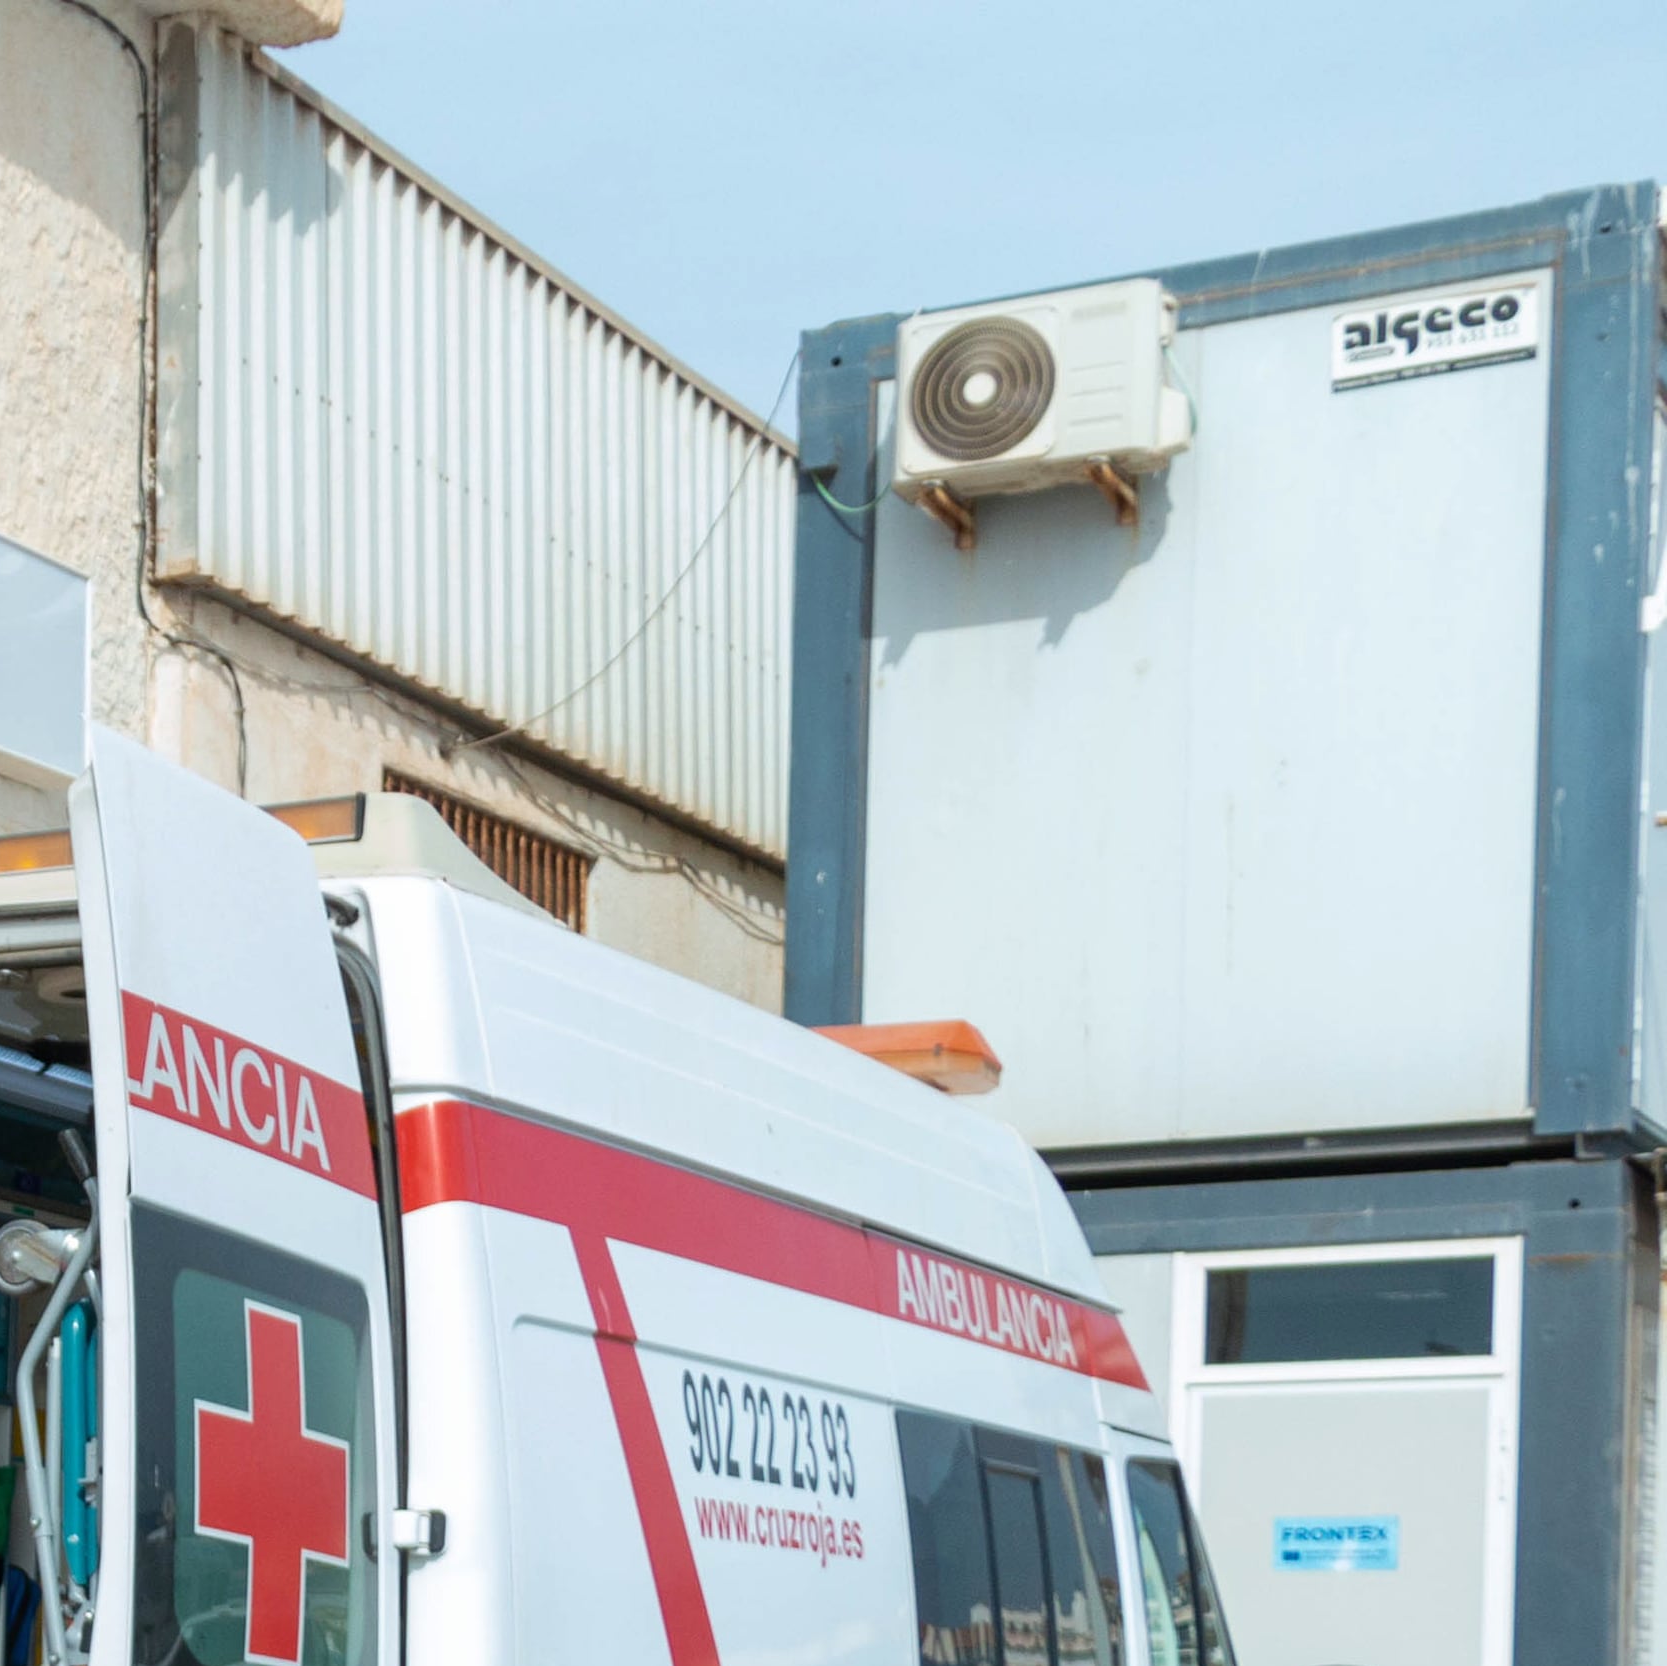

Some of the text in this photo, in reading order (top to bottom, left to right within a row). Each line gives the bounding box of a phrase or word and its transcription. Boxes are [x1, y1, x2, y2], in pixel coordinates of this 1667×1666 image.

[1344, 295, 1520, 356] algeco
[127, 1012, 332, 1173] ANCIA
[895, 1249, 1079, 1367] AMBULANCIA
[683, 1369, 855, 1499] 902 22 23 93
[695, 1496, 865, 1568] www.cruzroja.es
[1281, 1525, 1388, 1541] FRONTEX
